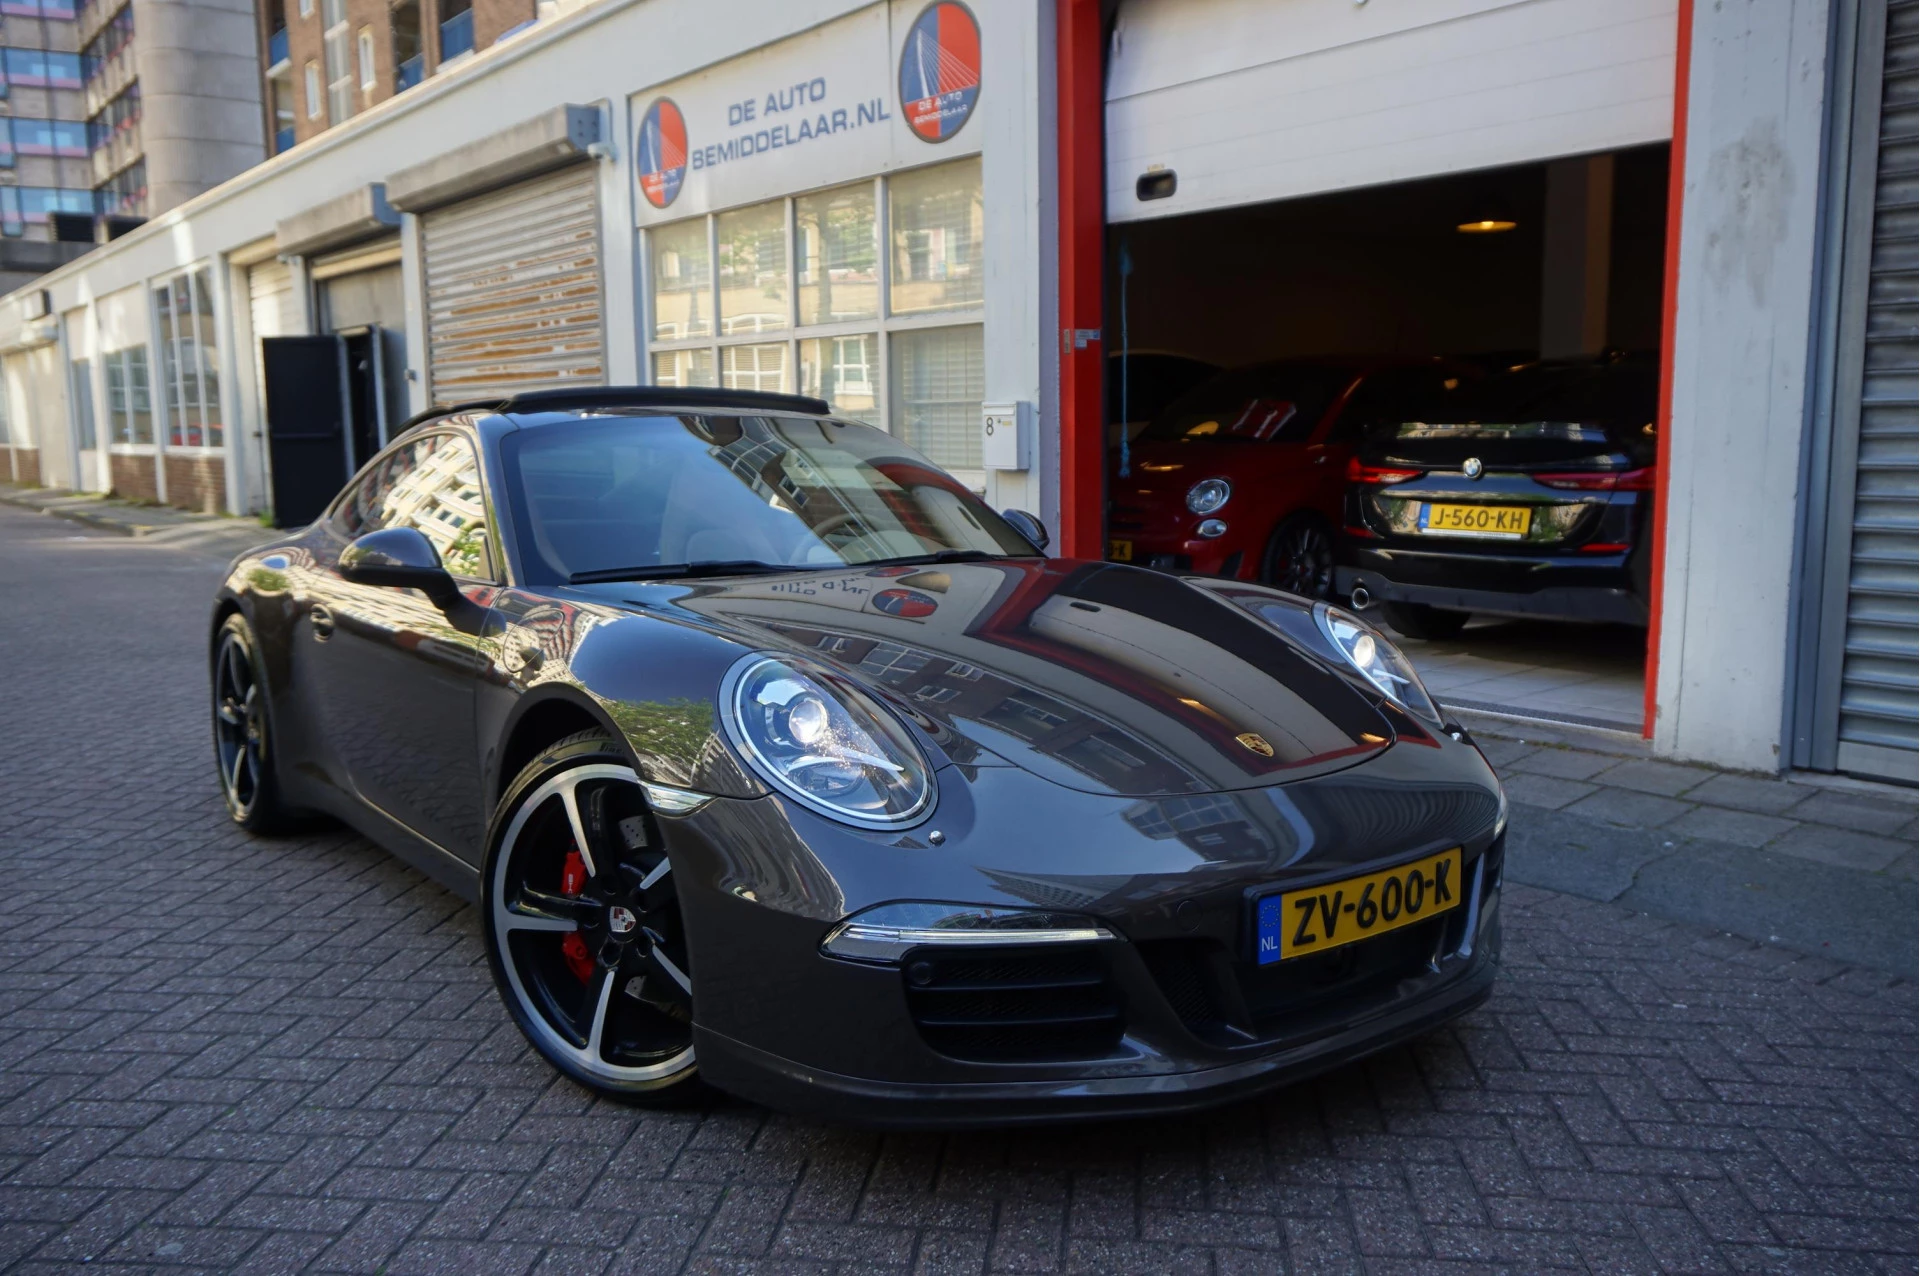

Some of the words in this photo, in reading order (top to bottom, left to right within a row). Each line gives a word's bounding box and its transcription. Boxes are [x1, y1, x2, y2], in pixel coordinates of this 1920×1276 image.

[729, 98, 756, 127] DE
[763, 76, 827, 117] AUTO
[917, 99, 932, 111] DE
[692, 97, 892, 171] BEMIDDELAAR.NL
[986, 416, 995, 437] 8
[1435, 507, 1524, 530] J-560-KH
[1261, 935, 1278, 953] NL
[1292, 858, 1452, 947] ZV-600-K
